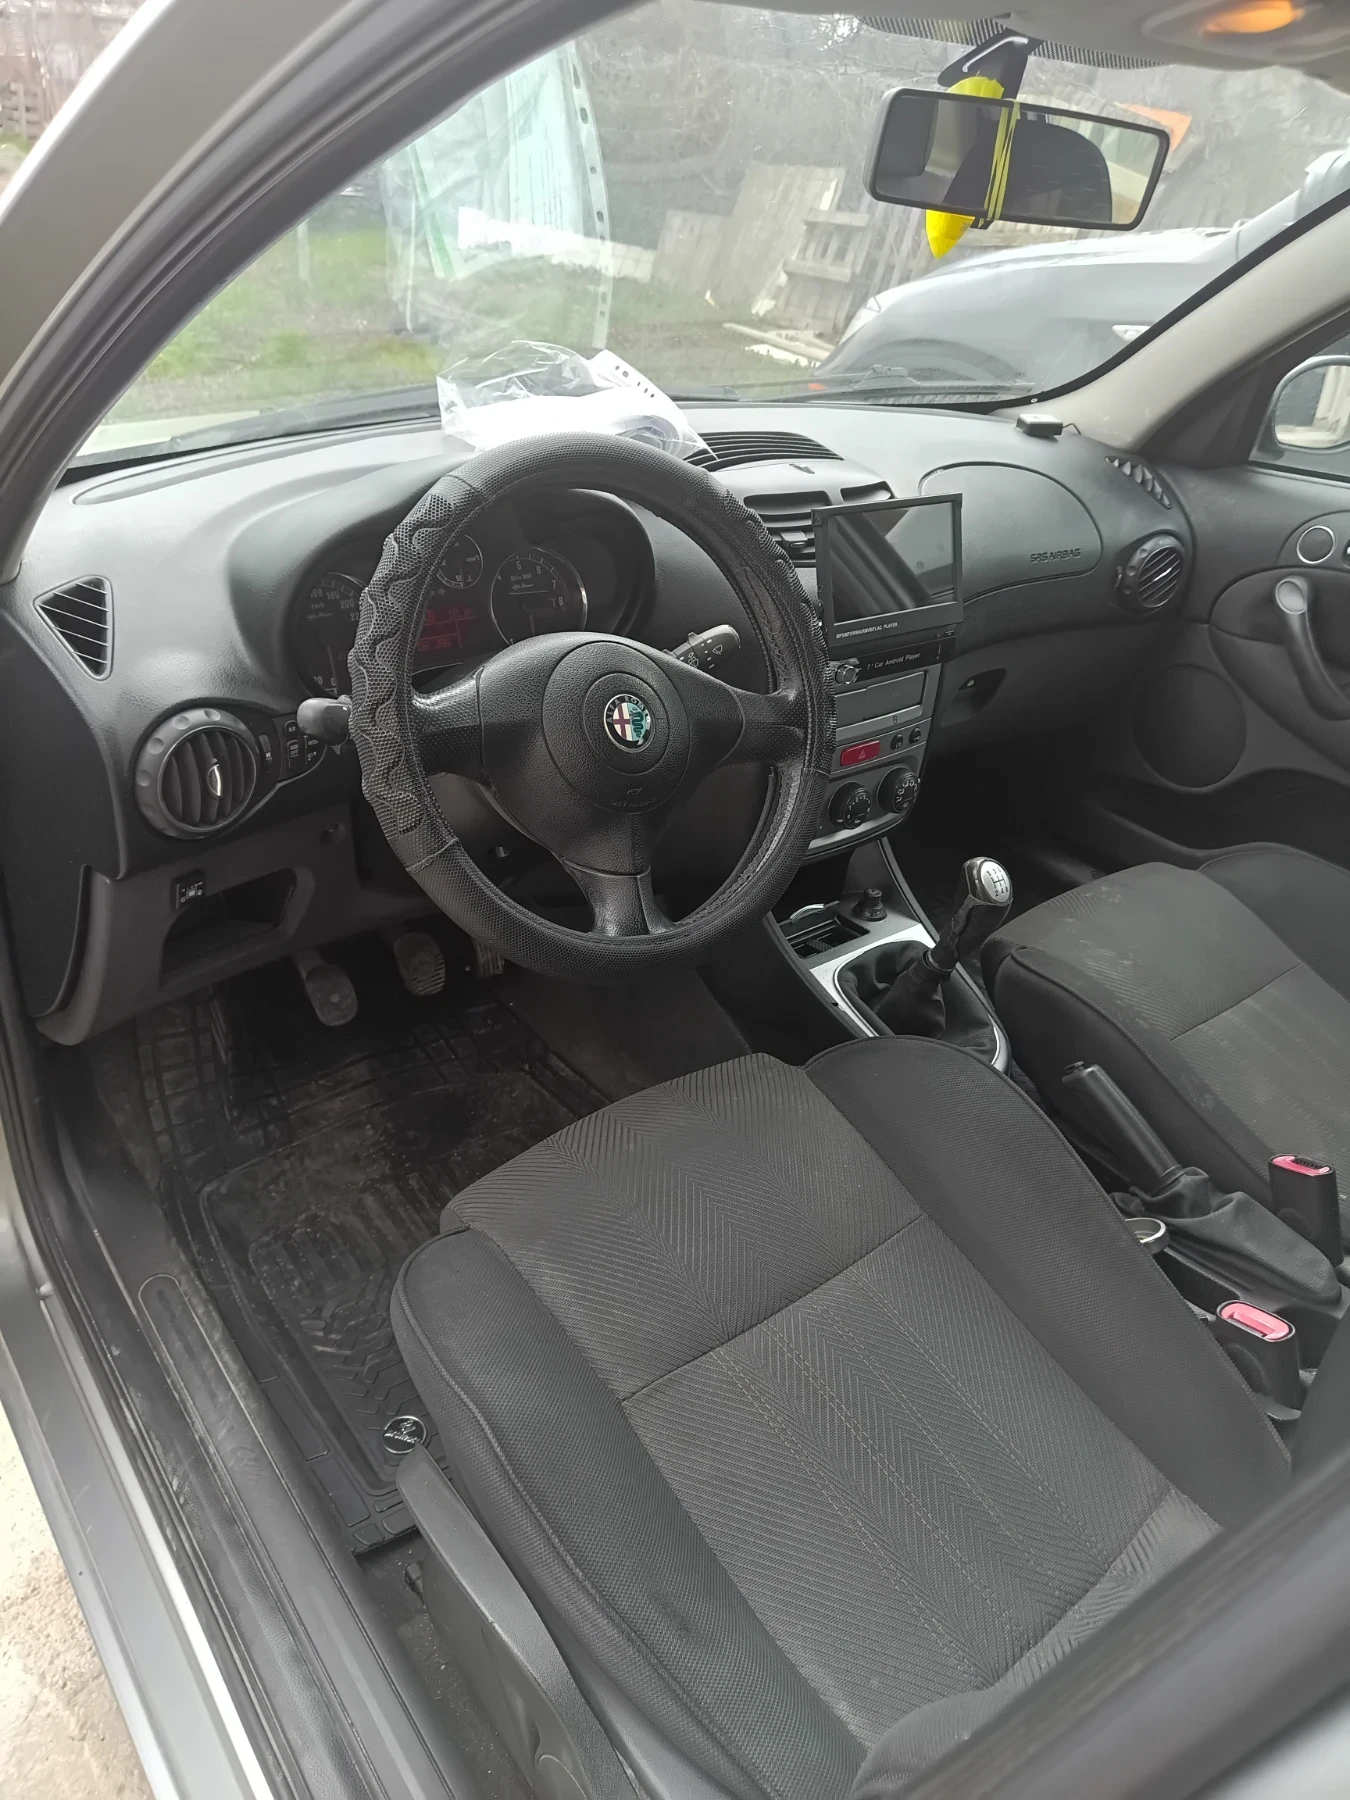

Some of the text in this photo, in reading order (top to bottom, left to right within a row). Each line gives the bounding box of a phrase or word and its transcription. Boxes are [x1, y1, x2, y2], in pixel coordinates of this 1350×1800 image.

[1030, 547, 1081, 564] SRS AIRBAG
[516, 561, 521, 570] 5
[536, 565, 542, 574] 6
[326, 590, 340, 600] 180
[340, 599, 355, 609] 200
[883, 622, 898, 630] PLAYER
[874, 661, 884, 669] Car
[884, 656, 904, 666] Android
[905, 652, 921, 662] Player
[606, 698, 621, 723] ALFA
